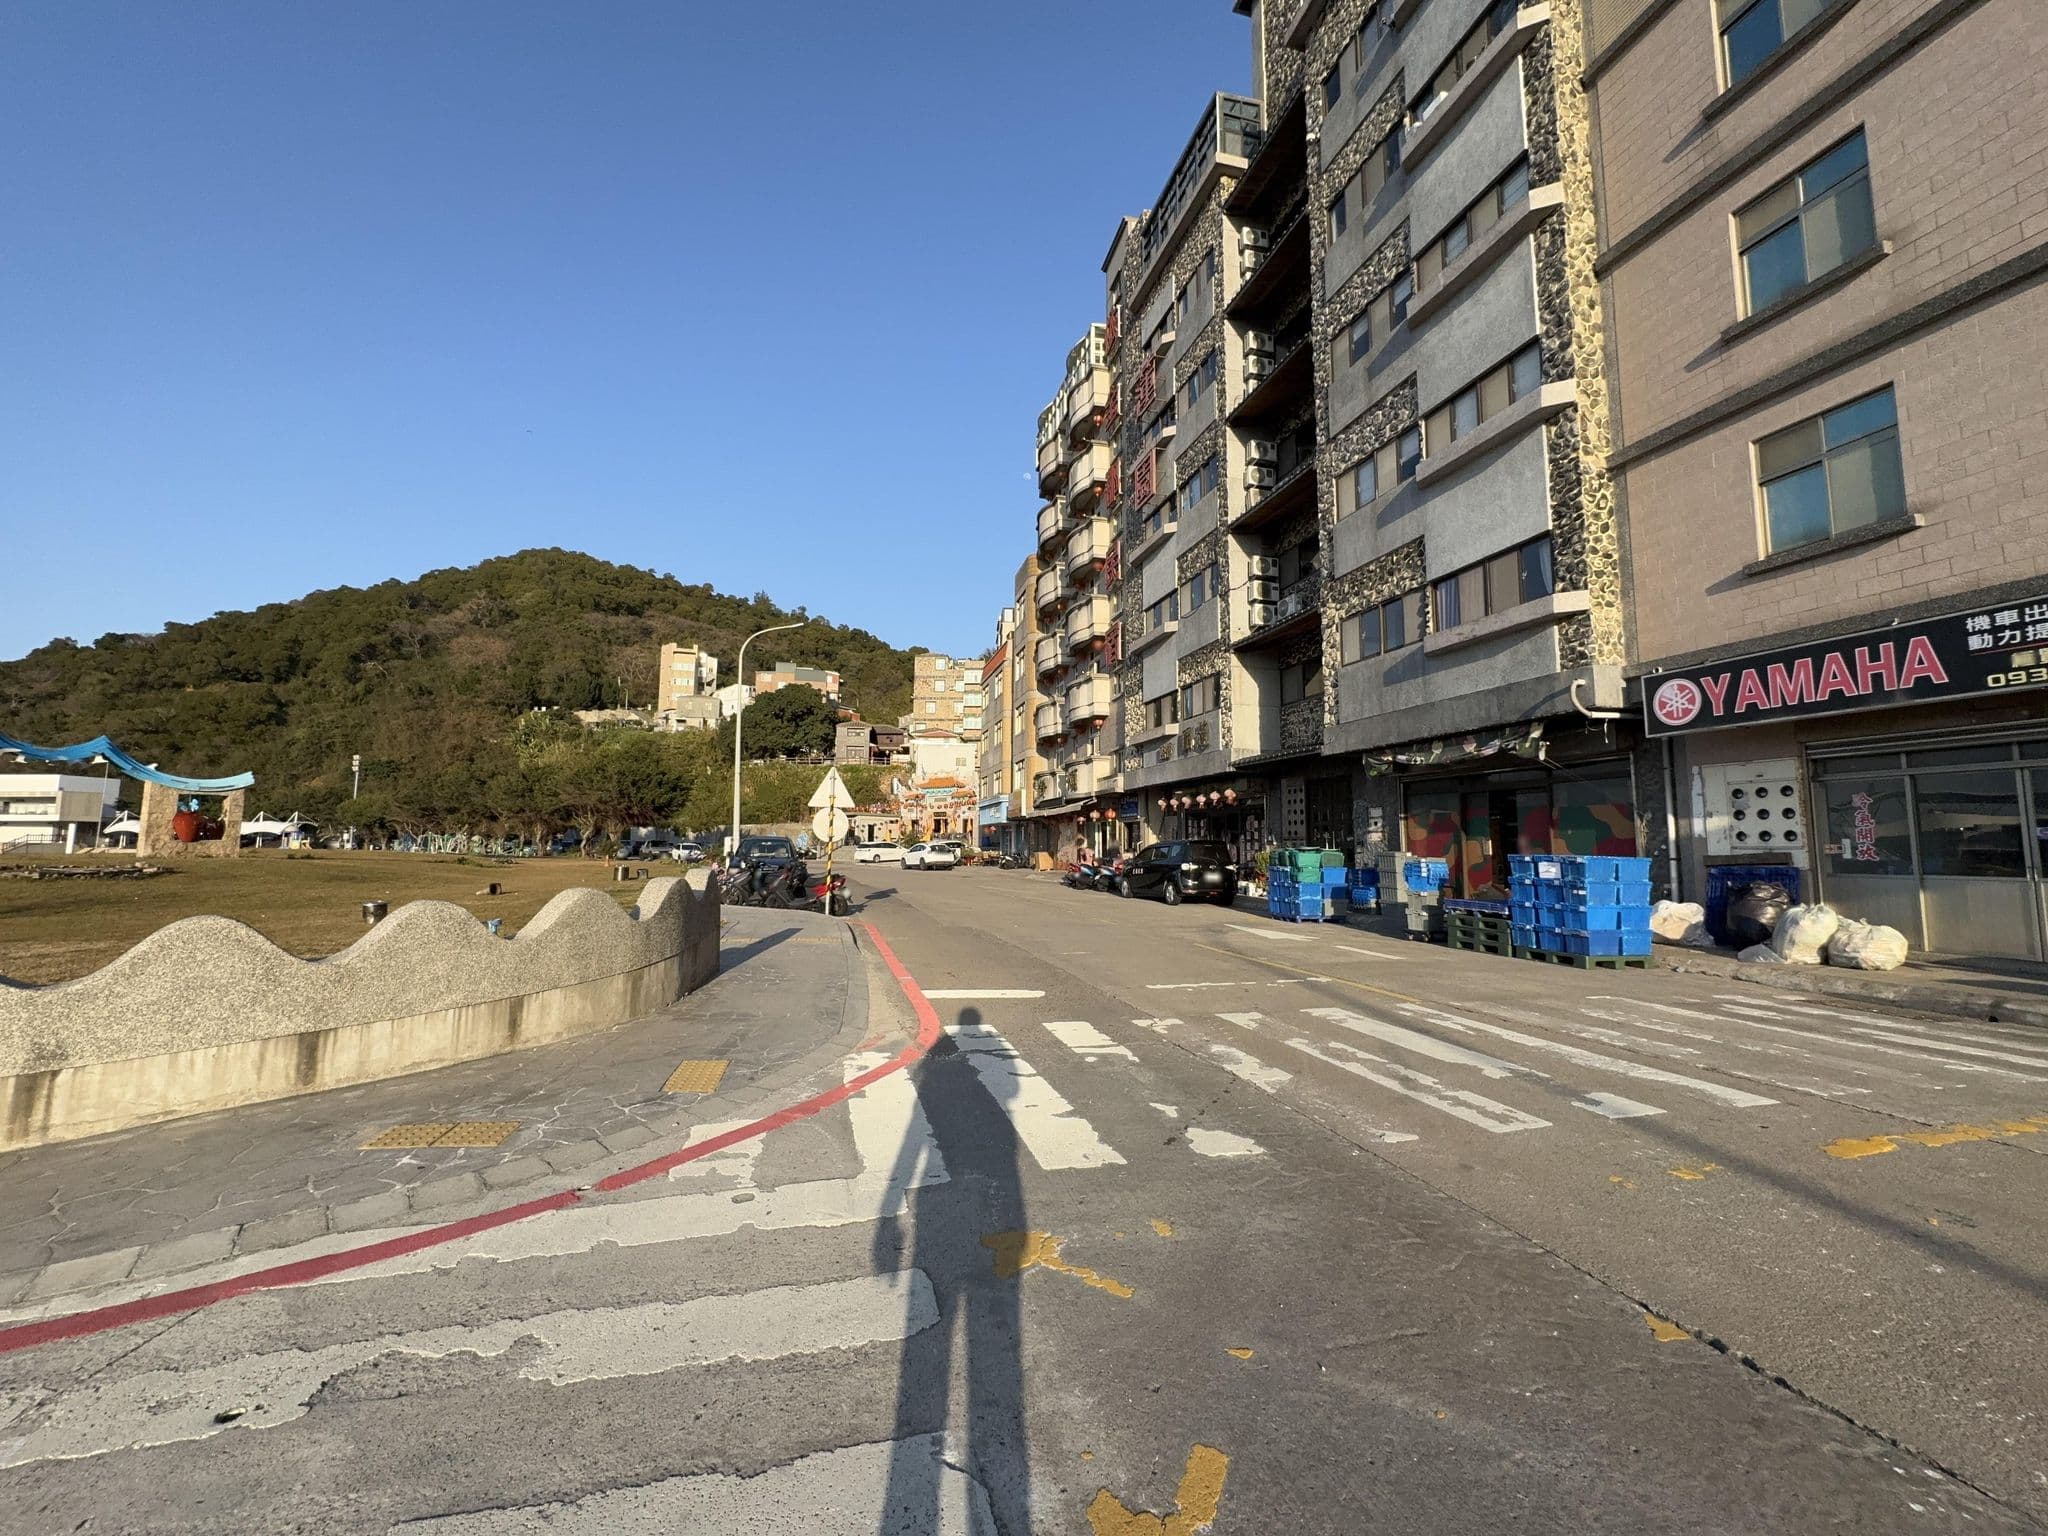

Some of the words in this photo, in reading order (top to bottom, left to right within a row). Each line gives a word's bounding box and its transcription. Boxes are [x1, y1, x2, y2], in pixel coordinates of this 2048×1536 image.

[1966, 604, 2048, 632] 機車出
[1700, 635, 1949, 716] YAMAHA
[1987, 667, 2048, 687] 093
[1851, 791, 1880, 861] 冷氣開放
